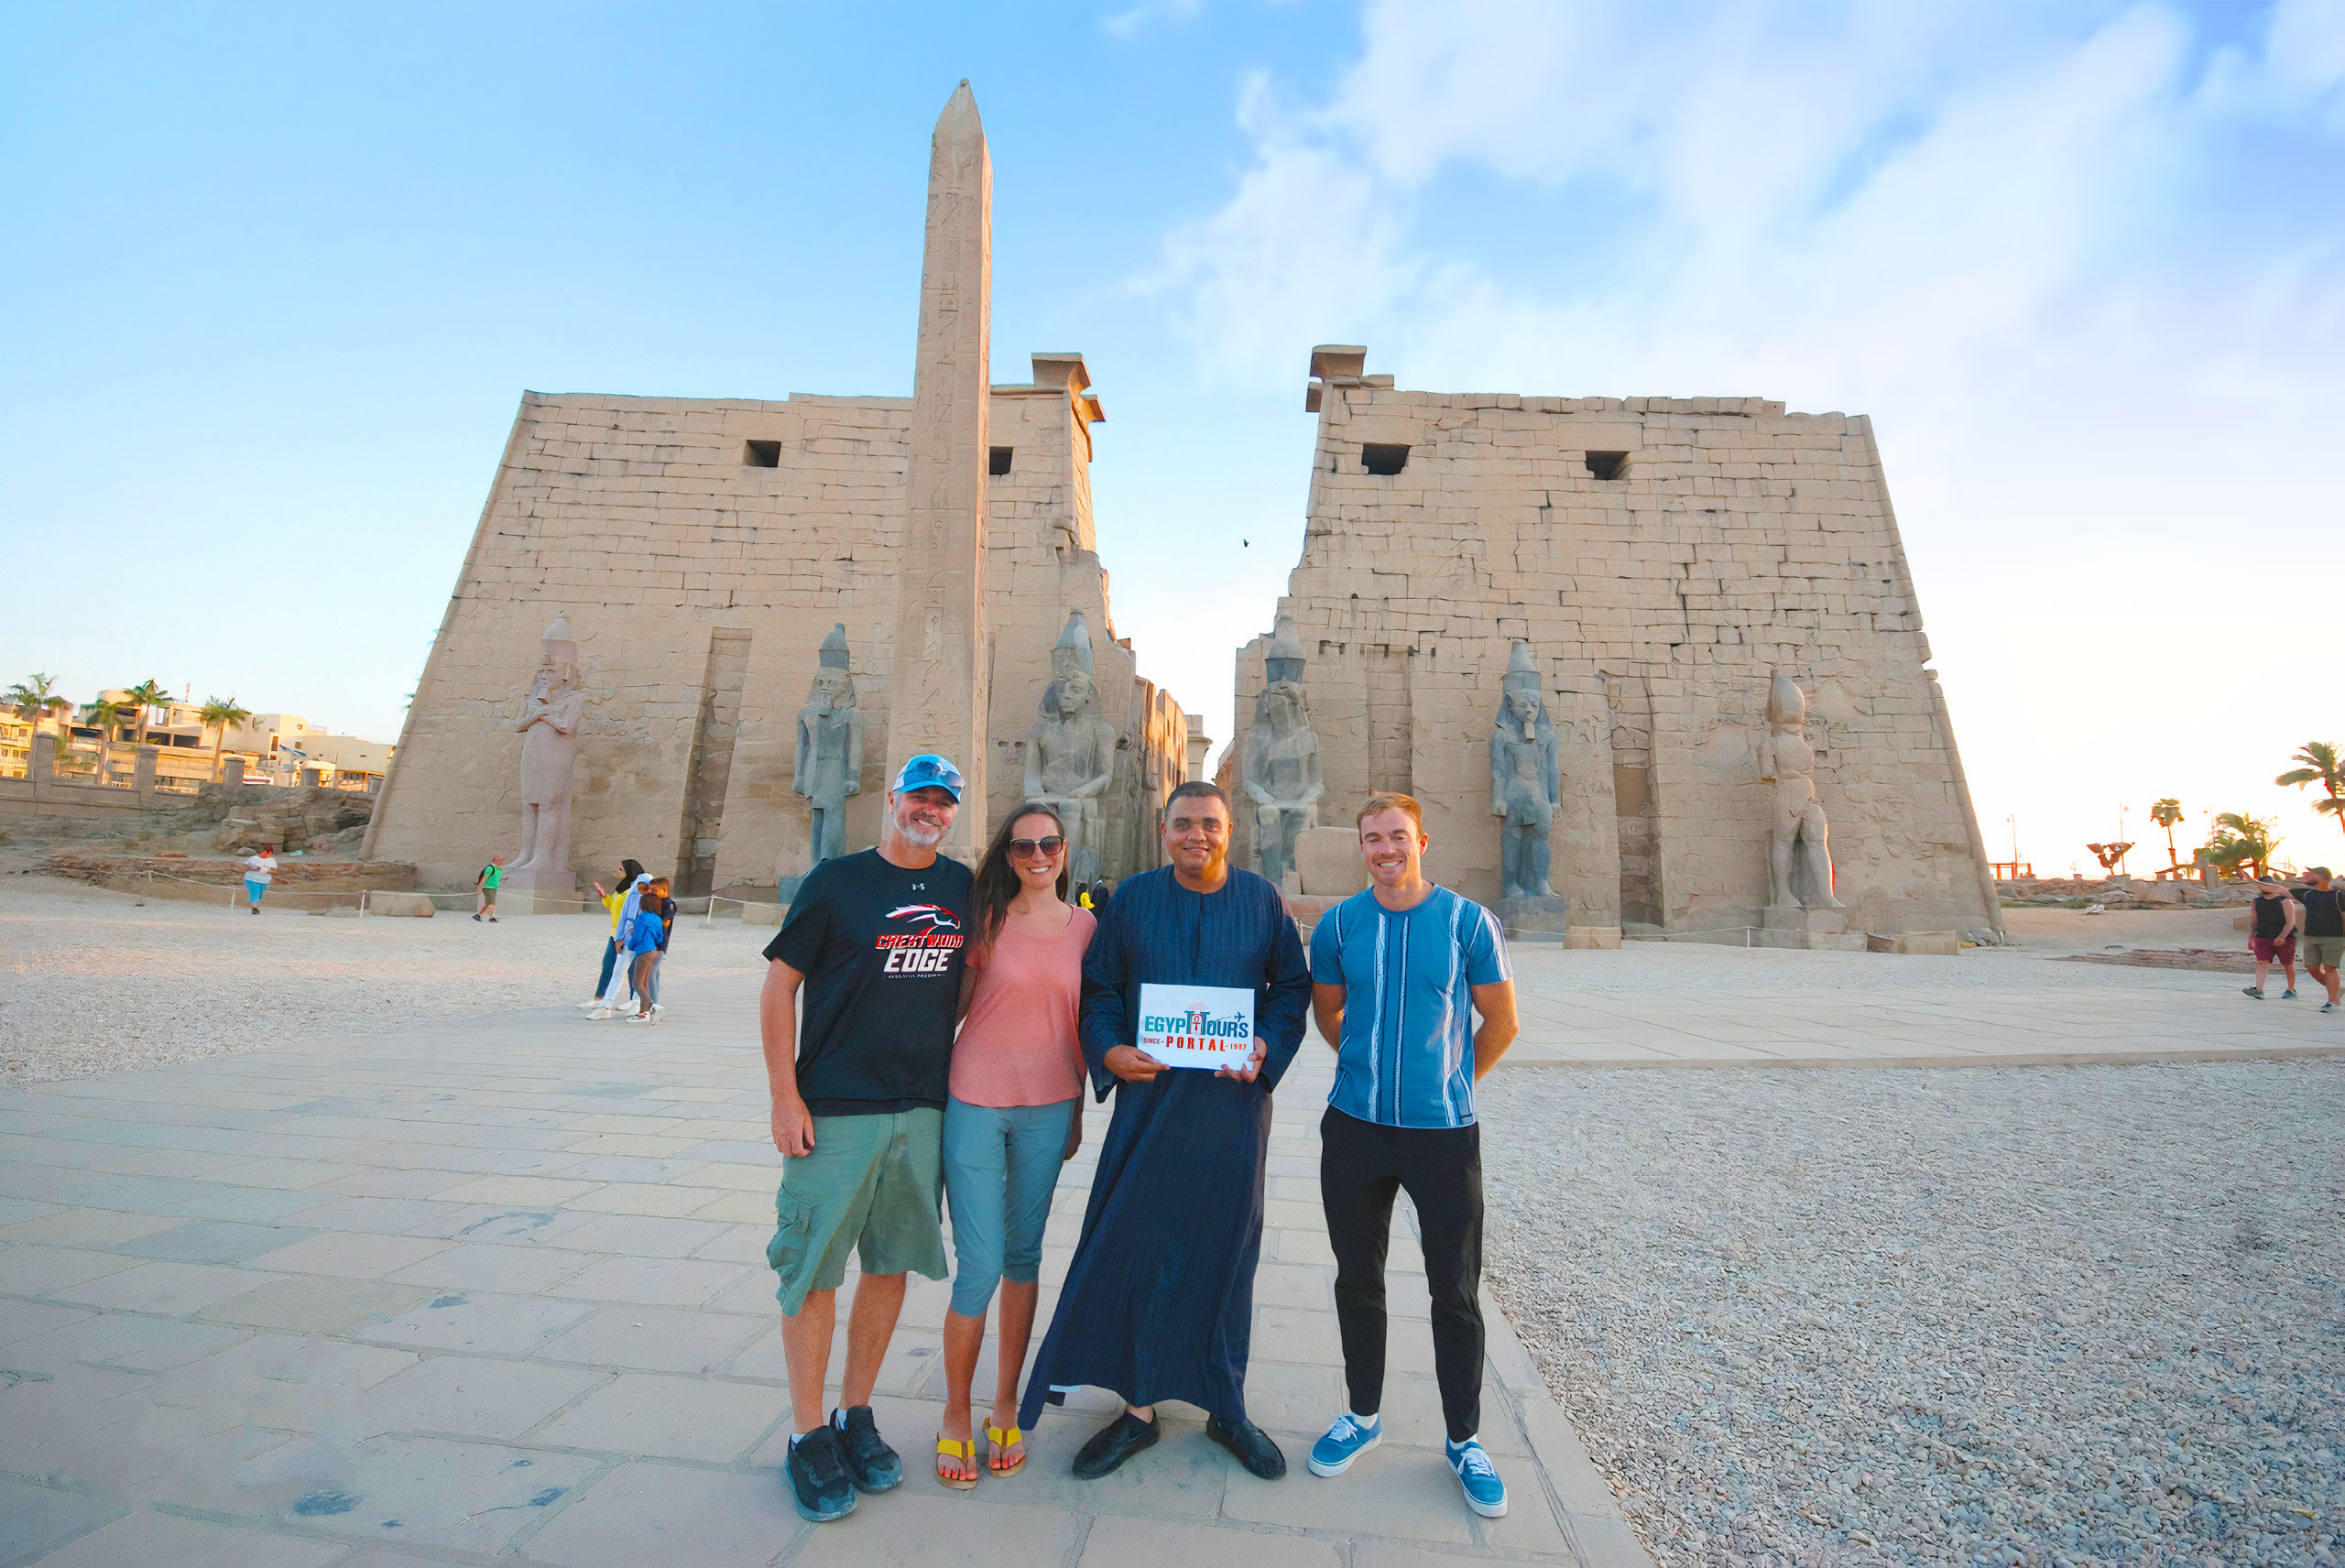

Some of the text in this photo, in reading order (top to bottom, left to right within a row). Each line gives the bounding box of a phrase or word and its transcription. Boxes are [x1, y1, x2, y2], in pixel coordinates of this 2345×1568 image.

[883, 948, 954, 973] EDGE
[1144, 1010, 1249, 1039] EGYPT TOURS
[1165, 1035, 1226, 1052] PORTAL
